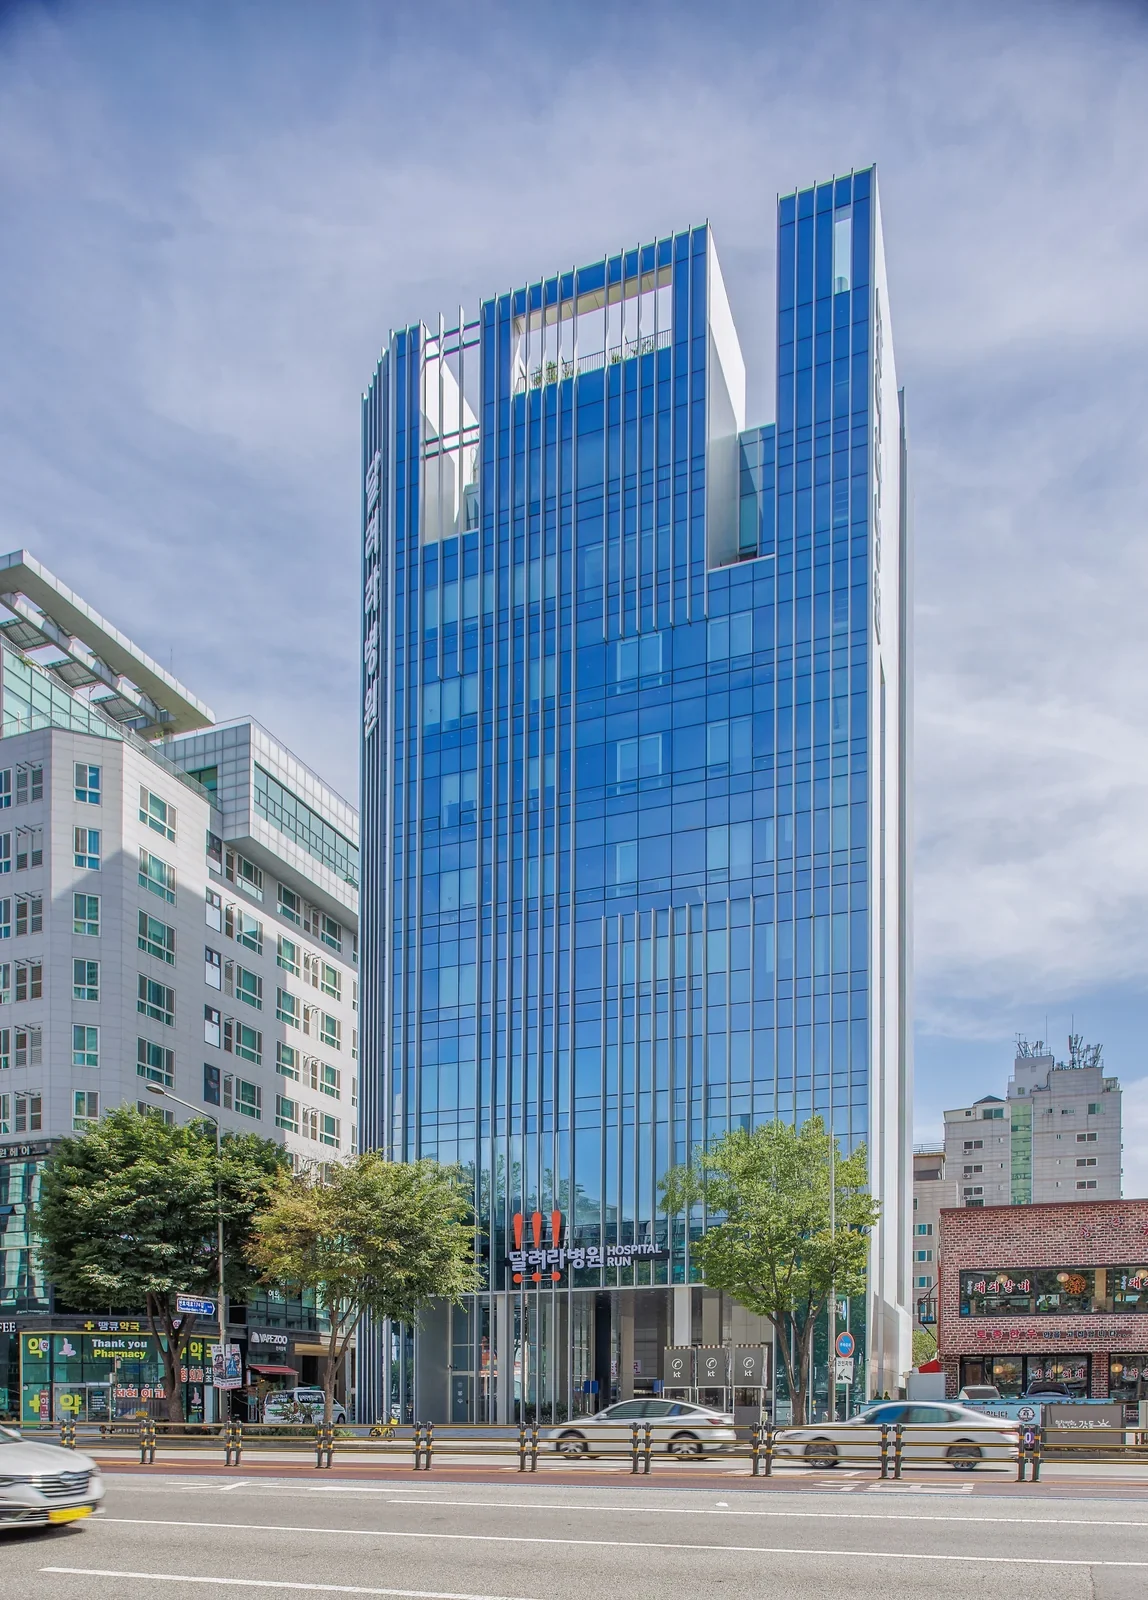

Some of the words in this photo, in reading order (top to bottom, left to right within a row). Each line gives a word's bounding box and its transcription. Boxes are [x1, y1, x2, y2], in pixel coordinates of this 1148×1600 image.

[365, 449, 382, 741] 달려라병원
[606, 1244, 663, 1256] HOSPITAL
[509, 1246, 605, 1272] 달려라병원
[606, 1256, 632, 1267] RUN
[97, 1320, 140, 1332] 땡큐약국
[92, 1339, 125, 1348] Thank
[128, 1341, 148, 1350] you
[259, 1333, 288, 1345] VAPEZOO
[93, 1349, 146, 1360] Pharmacy
[707, 1370, 715, 1378] kt
[59, 1394, 82, 1414] 약
